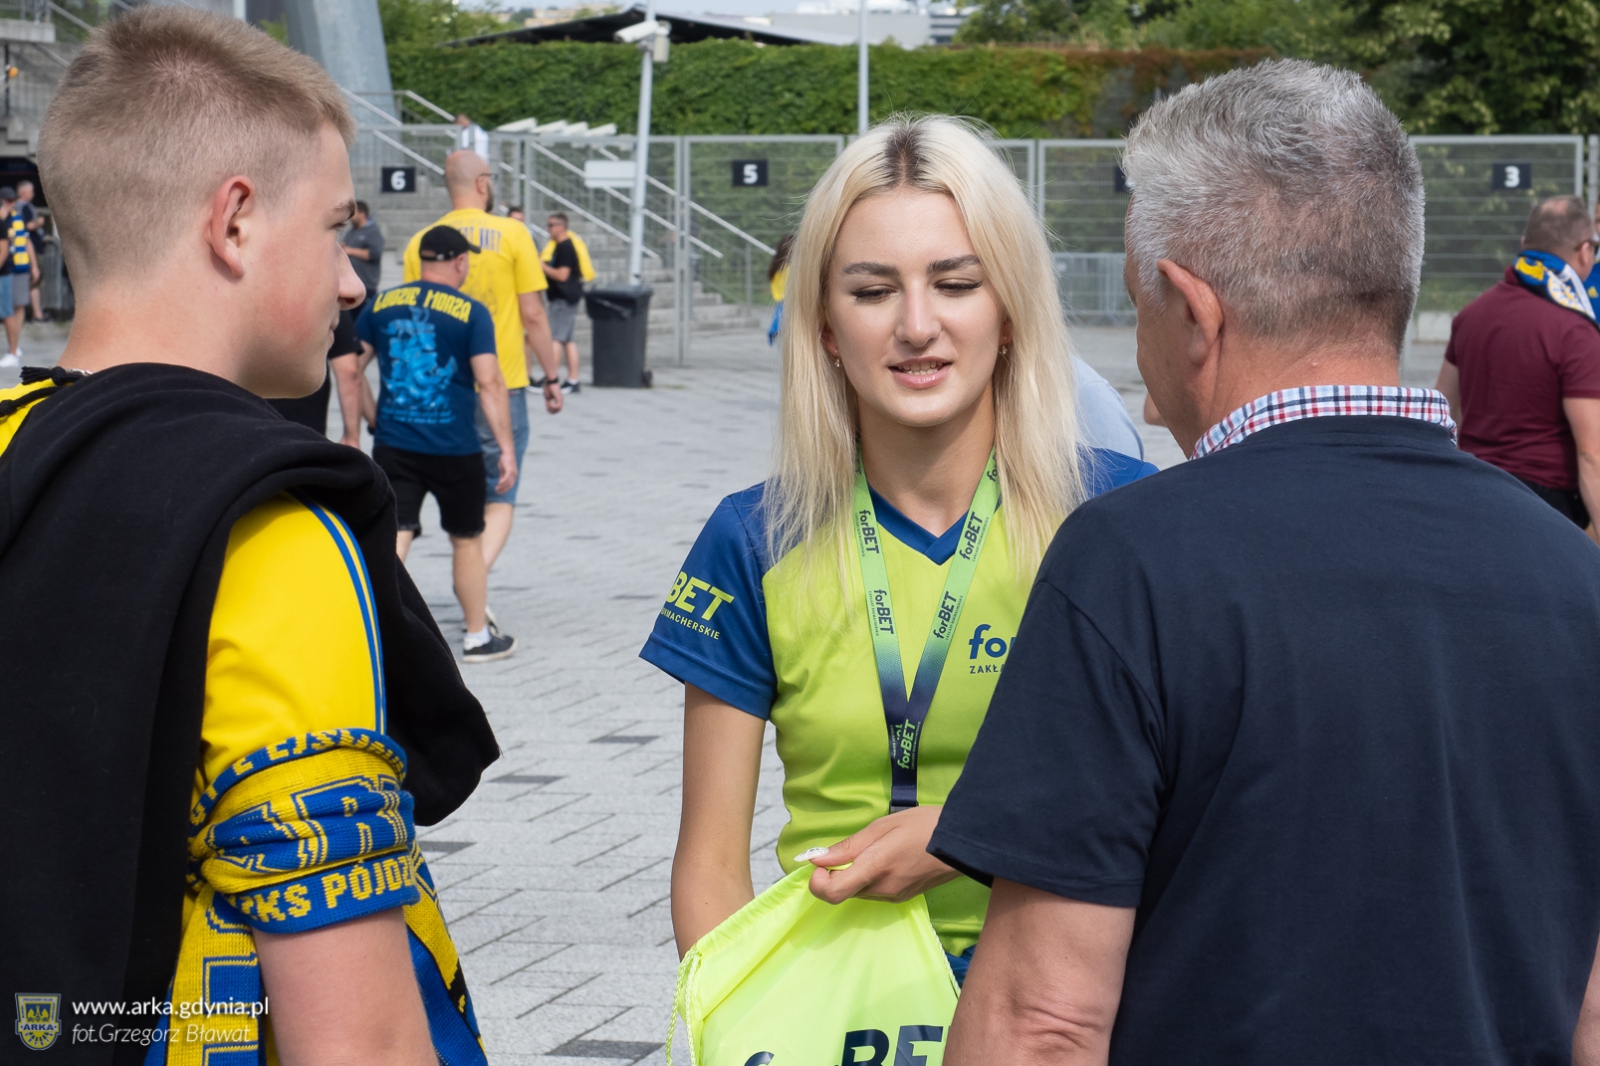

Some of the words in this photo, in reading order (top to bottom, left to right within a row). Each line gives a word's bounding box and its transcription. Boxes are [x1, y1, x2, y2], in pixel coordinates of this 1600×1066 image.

[390, 170, 406, 191] 6
[743, 163, 758, 185] 5
[1504, 165, 1520, 188] 3
[859, 509, 880, 554] forBET
[959, 511, 983, 560] forBET
[874, 589, 894, 634] forBET
[933, 590, 957, 639] forBET
[897, 719, 916, 769] forBET
[321, 856, 416, 909] PÓJDZ
